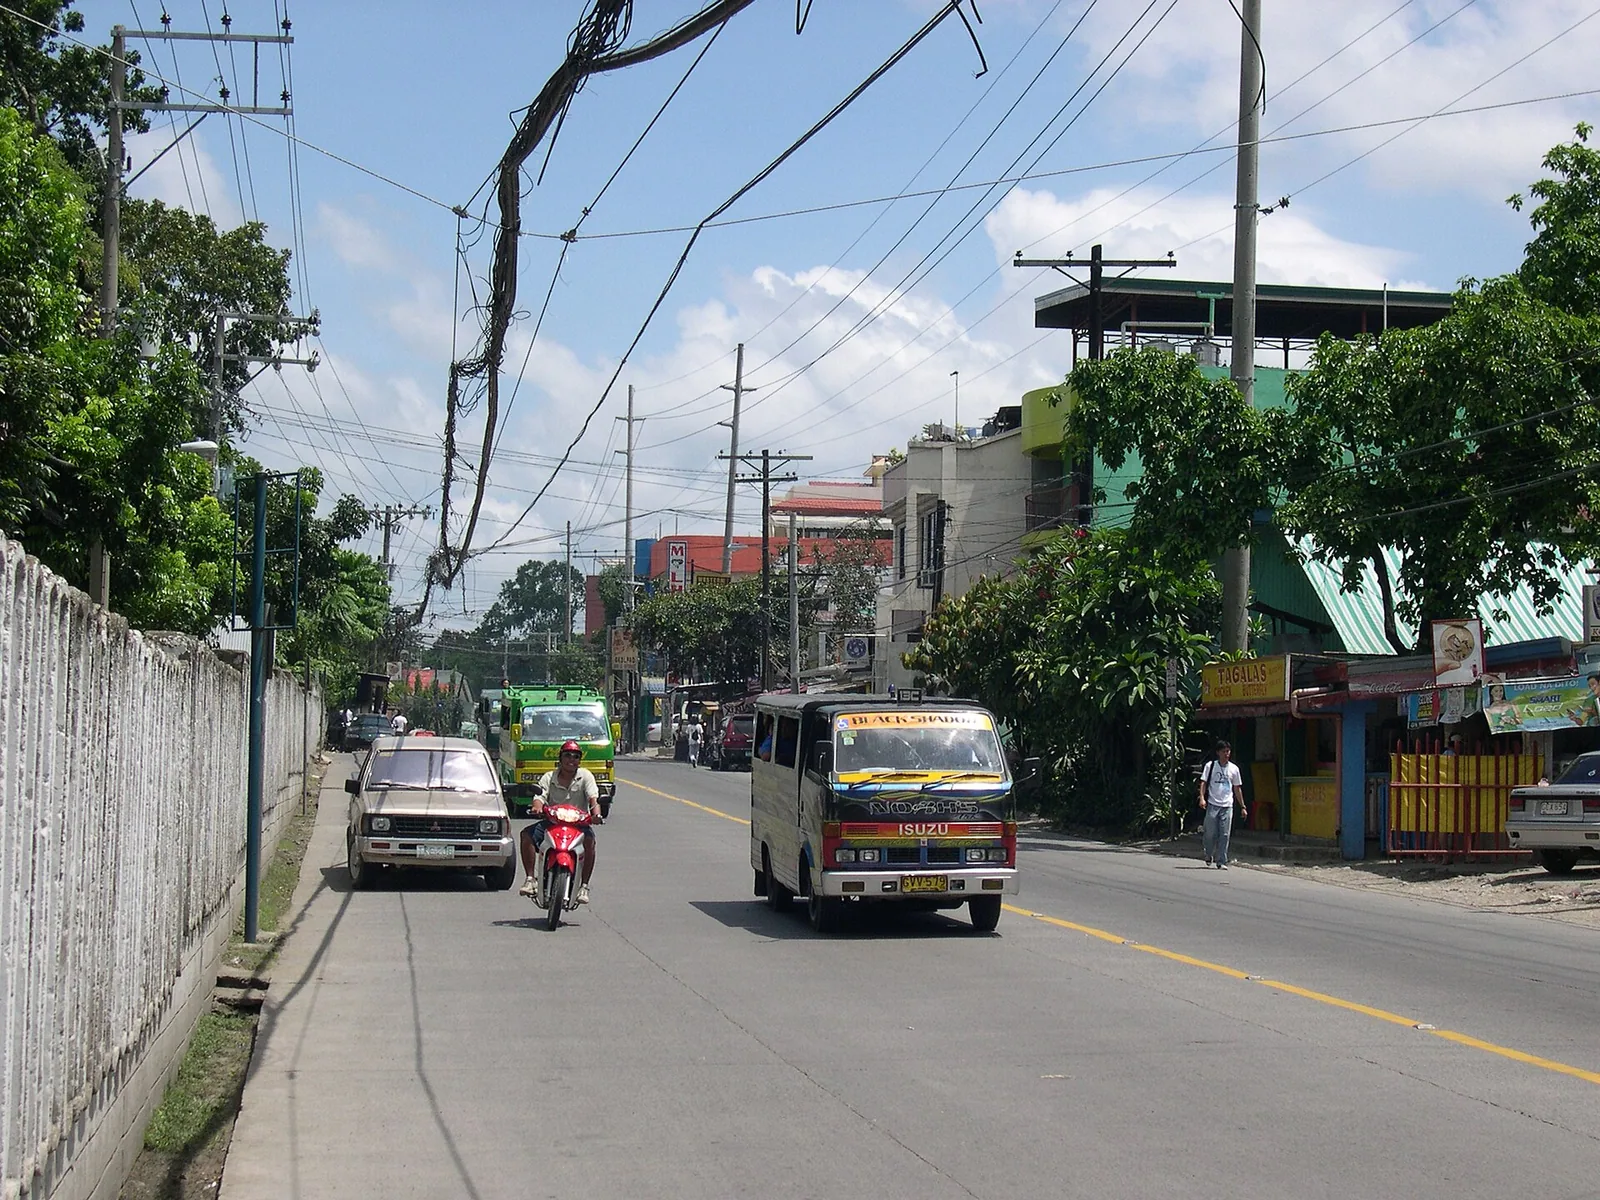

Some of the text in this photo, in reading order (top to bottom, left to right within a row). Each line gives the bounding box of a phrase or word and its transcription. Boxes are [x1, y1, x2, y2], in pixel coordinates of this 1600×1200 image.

[1217, 663, 1267, 686] TAGALAS
[1513, 684, 1537, 692] LOAD
[1529, 694, 1561, 704] SMART
[851, 715, 907, 725] BLACK
[898, 823, 949, 836] ISUZU
